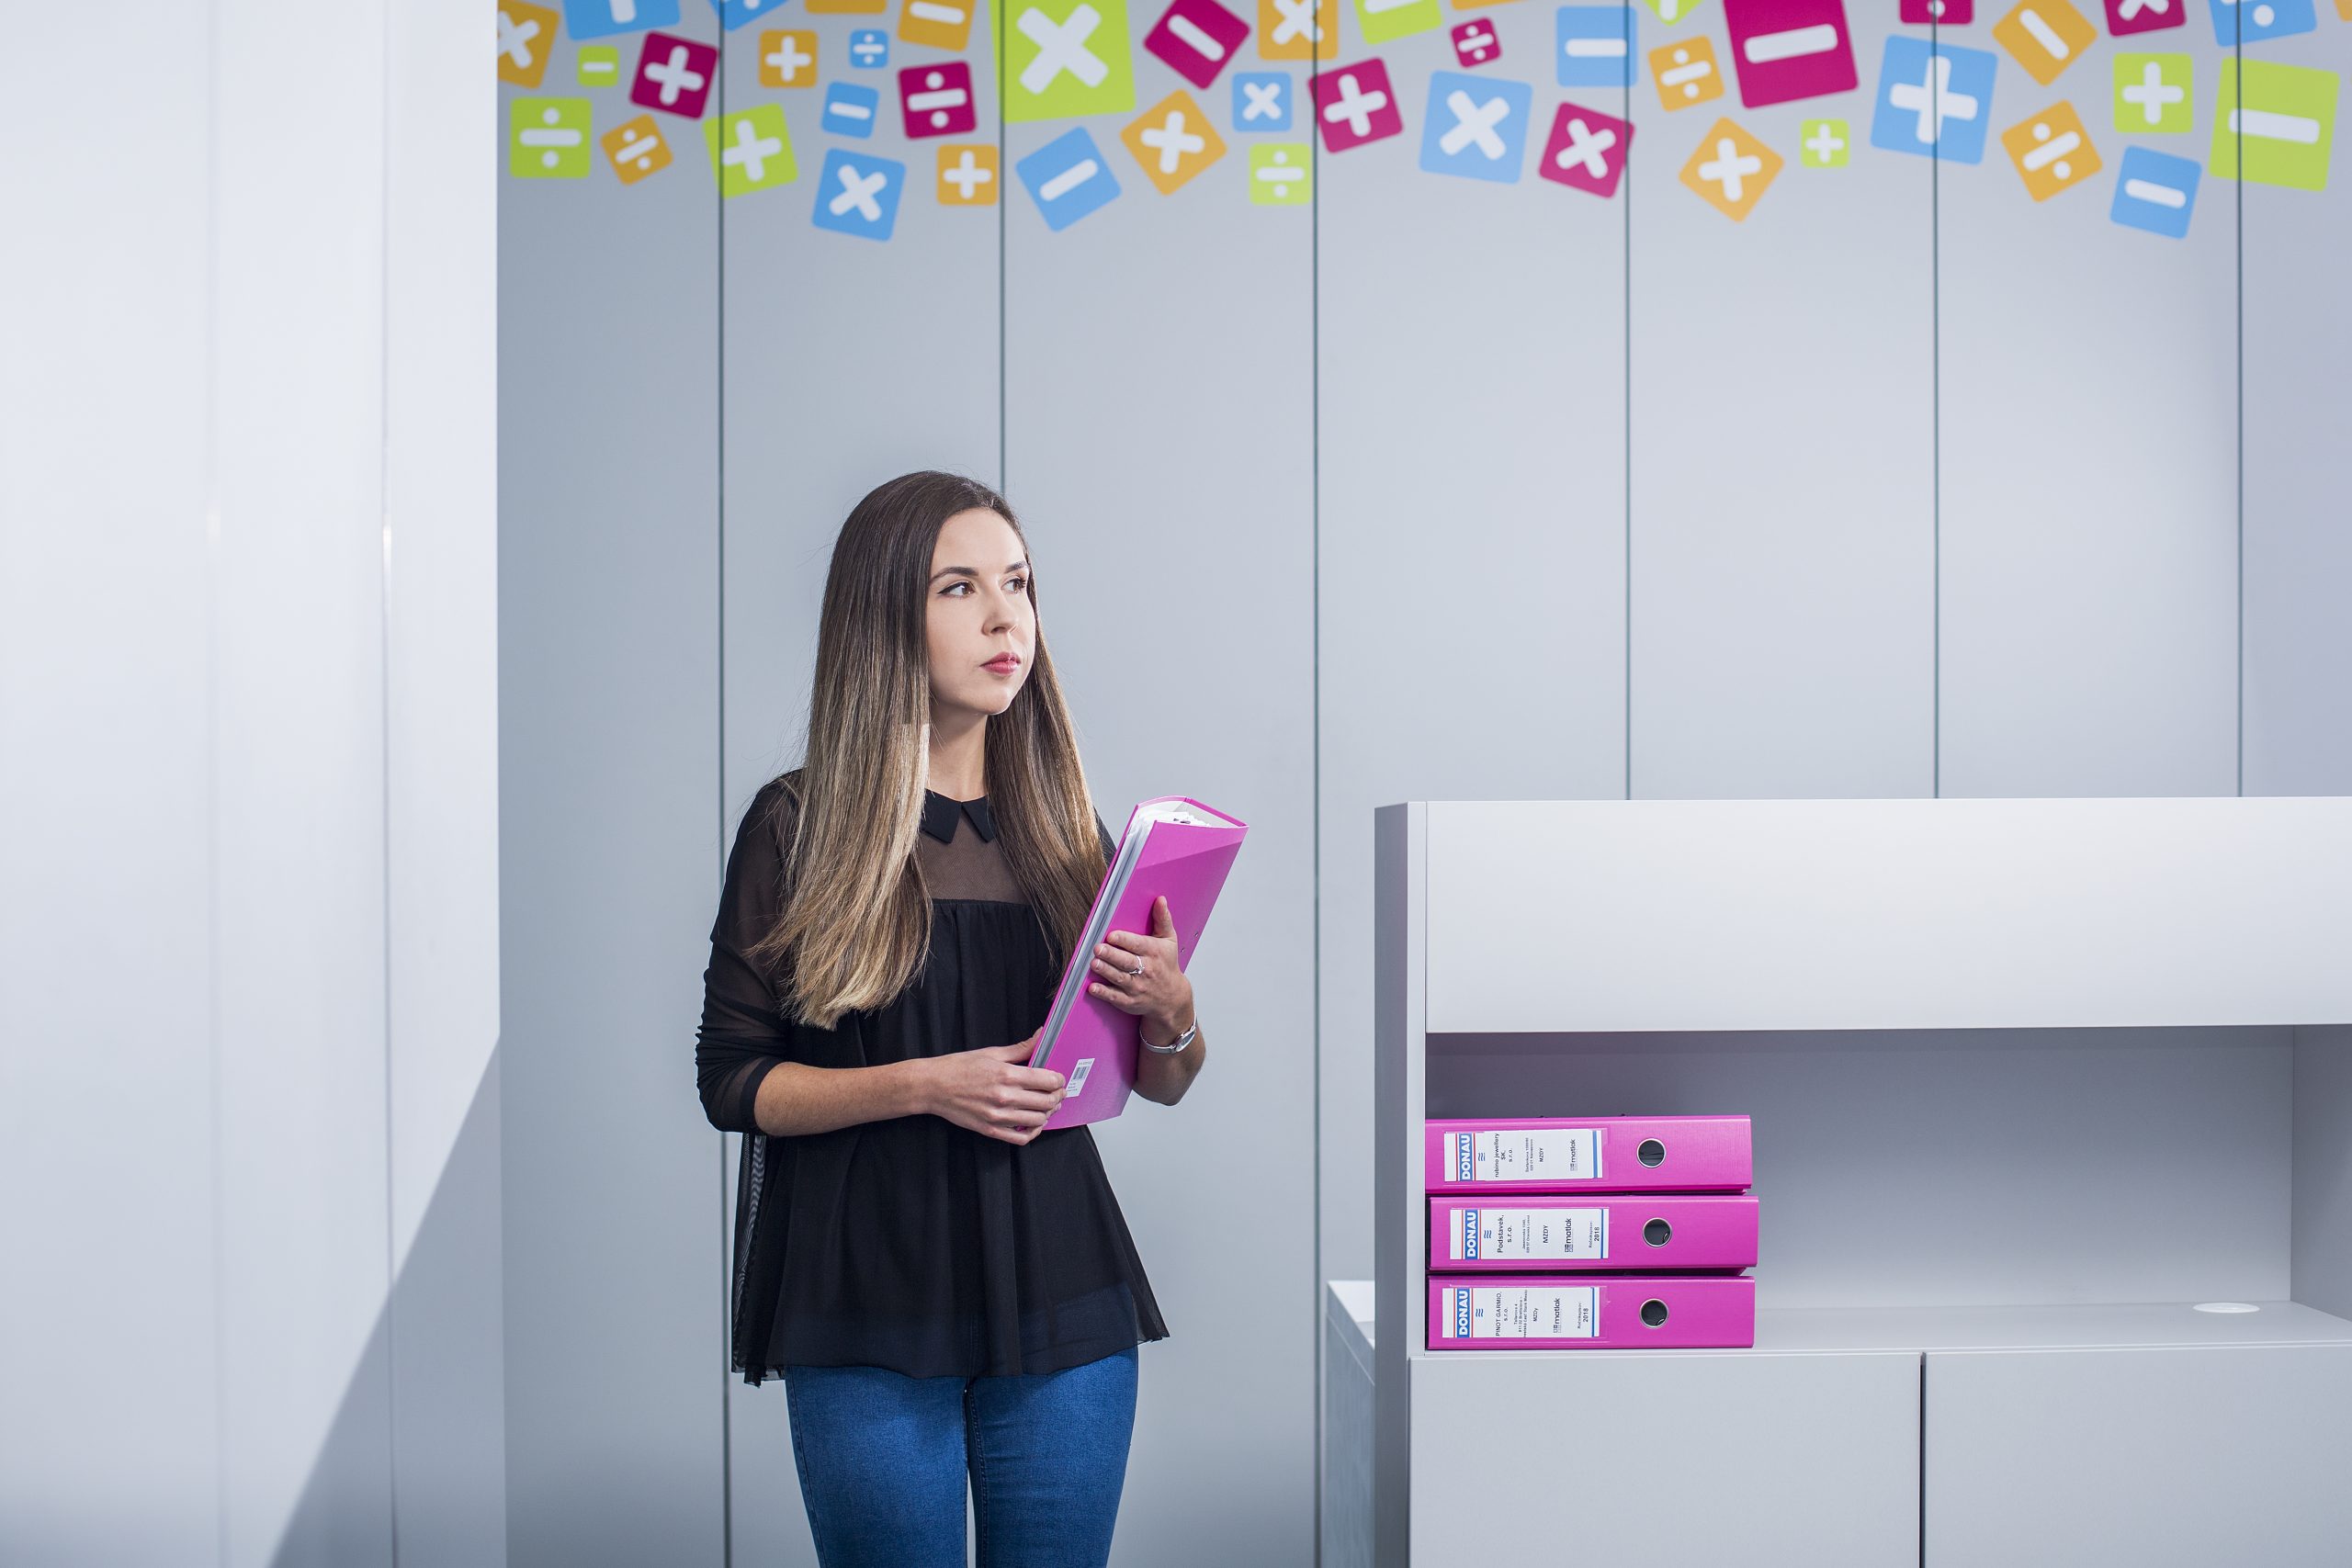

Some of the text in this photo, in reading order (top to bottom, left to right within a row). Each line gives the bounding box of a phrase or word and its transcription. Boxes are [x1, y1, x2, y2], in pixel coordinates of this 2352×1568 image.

[1461, 1134, 1471, 1180] DONAU
[1466, 1212, 1476, 1258] DONAU
[1458, 1291, 1468, 1336] DONAU
